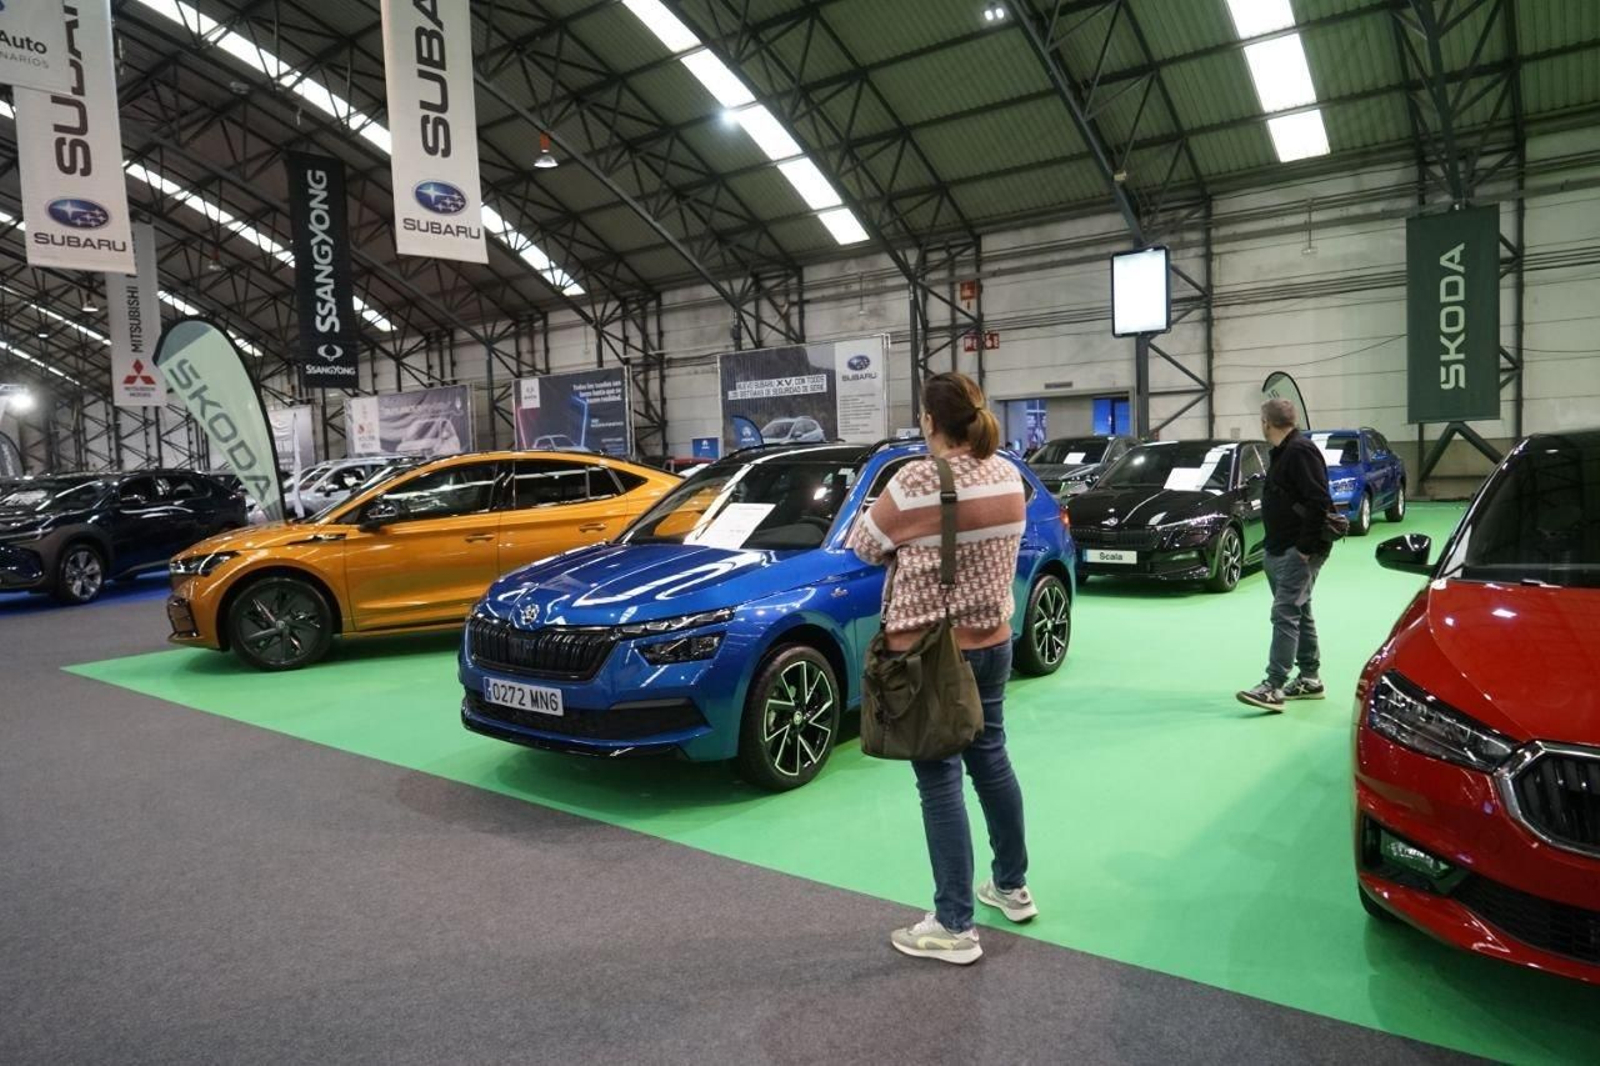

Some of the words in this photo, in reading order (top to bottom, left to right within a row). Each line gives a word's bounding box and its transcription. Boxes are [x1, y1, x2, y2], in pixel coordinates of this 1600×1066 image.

[403, 218, 480, 240] SUBARU
[34, 232, 127, 252] SUBARU
[307, 169, 340, 333] SSANGYONG
[126, 286, 143, 352] MITSUBISHI
[842, 372, 877, 382] SUBARU
[1099, 552, 1123, 561] Scala
[492, 683, 526, 707] 0272
